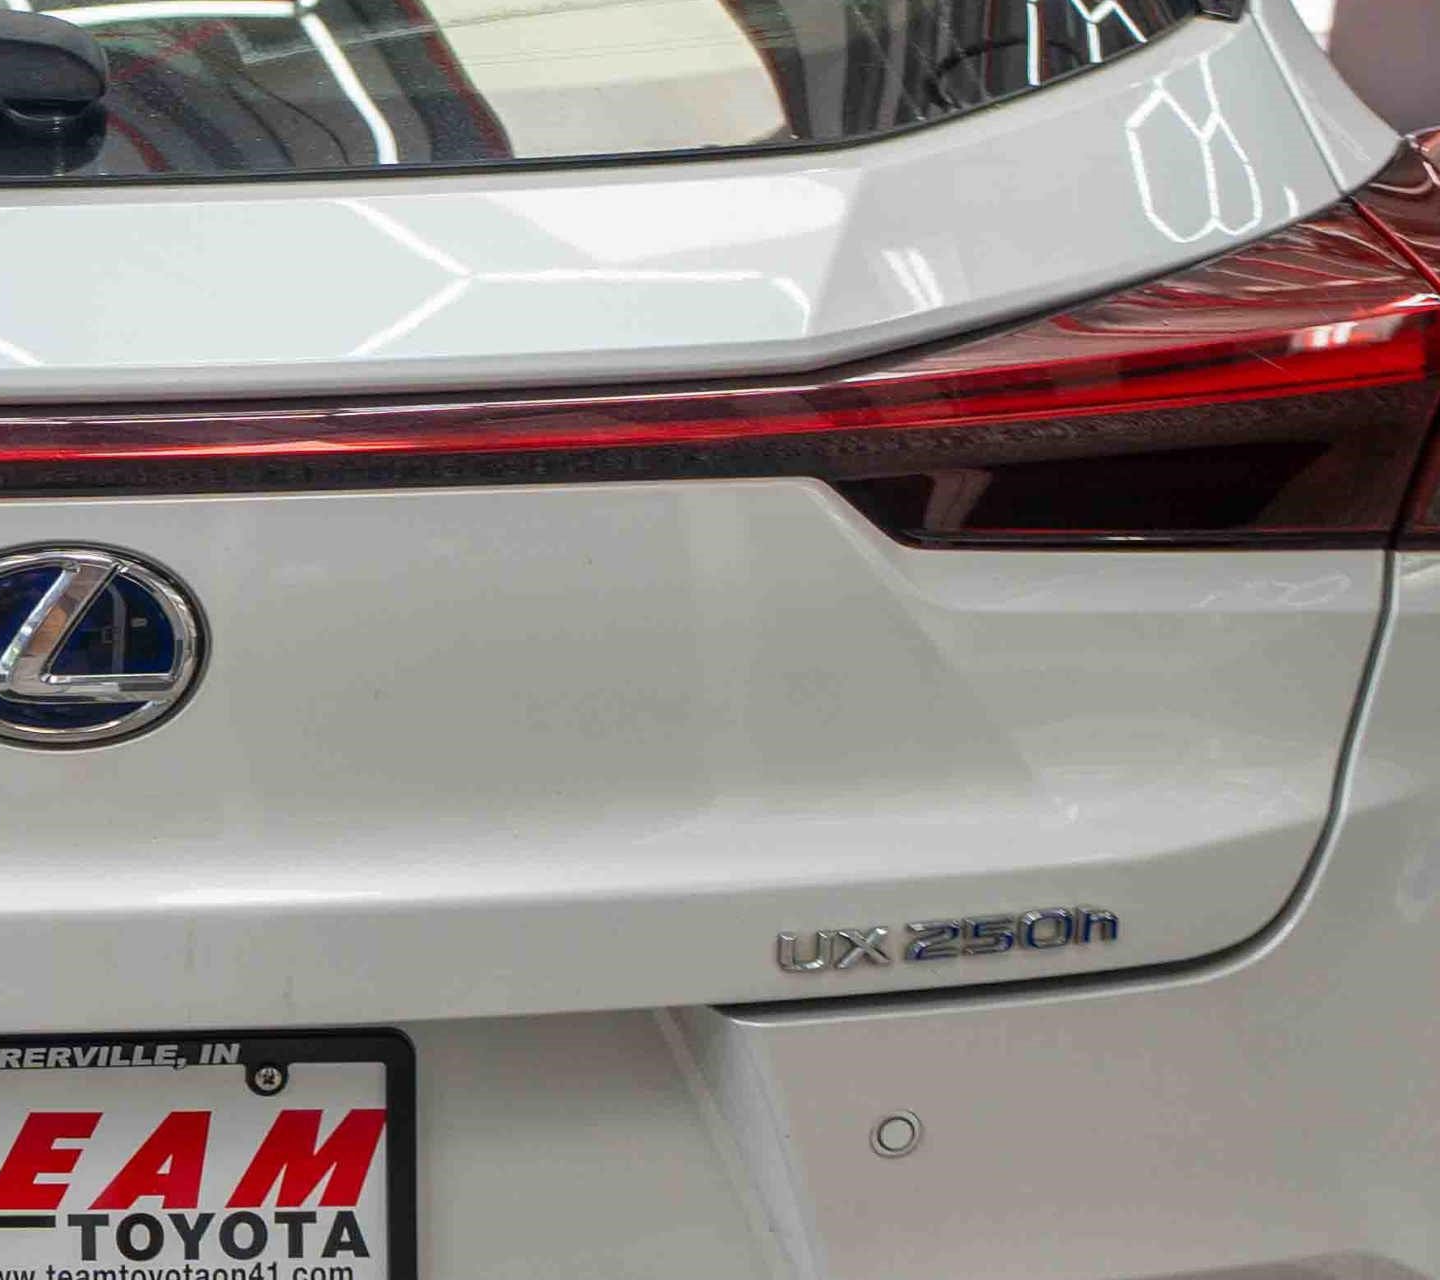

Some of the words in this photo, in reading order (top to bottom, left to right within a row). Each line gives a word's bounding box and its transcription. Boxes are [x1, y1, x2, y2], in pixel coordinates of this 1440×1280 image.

[776, 925, 891, 972] UX
[198, 1042, 241, 1065] IN
[67, 1210, 370, 1262] TOYOTA
